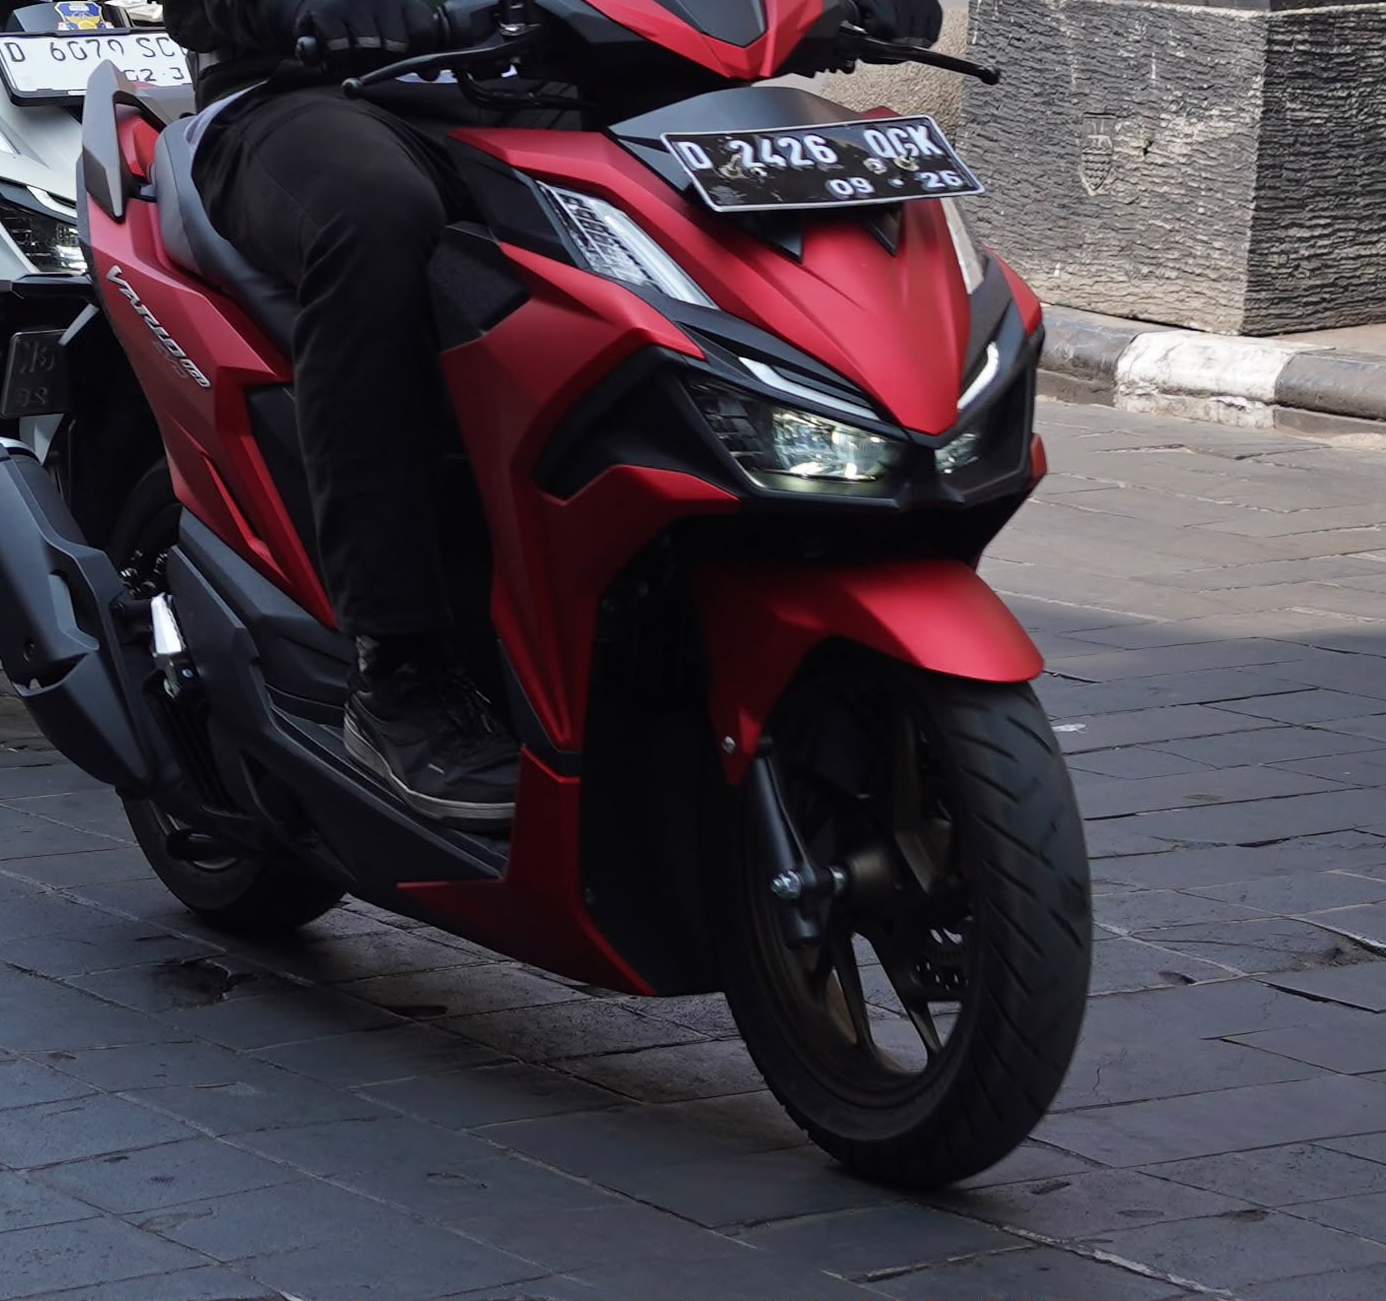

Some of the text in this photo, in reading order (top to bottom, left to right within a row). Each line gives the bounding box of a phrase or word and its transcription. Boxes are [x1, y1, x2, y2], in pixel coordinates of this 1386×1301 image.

[4, 42, 25, 62] D
[135, 36, 187, 58] SC
[677, 140, 713, 170] D
[728, 133, 838, 169] 2426
